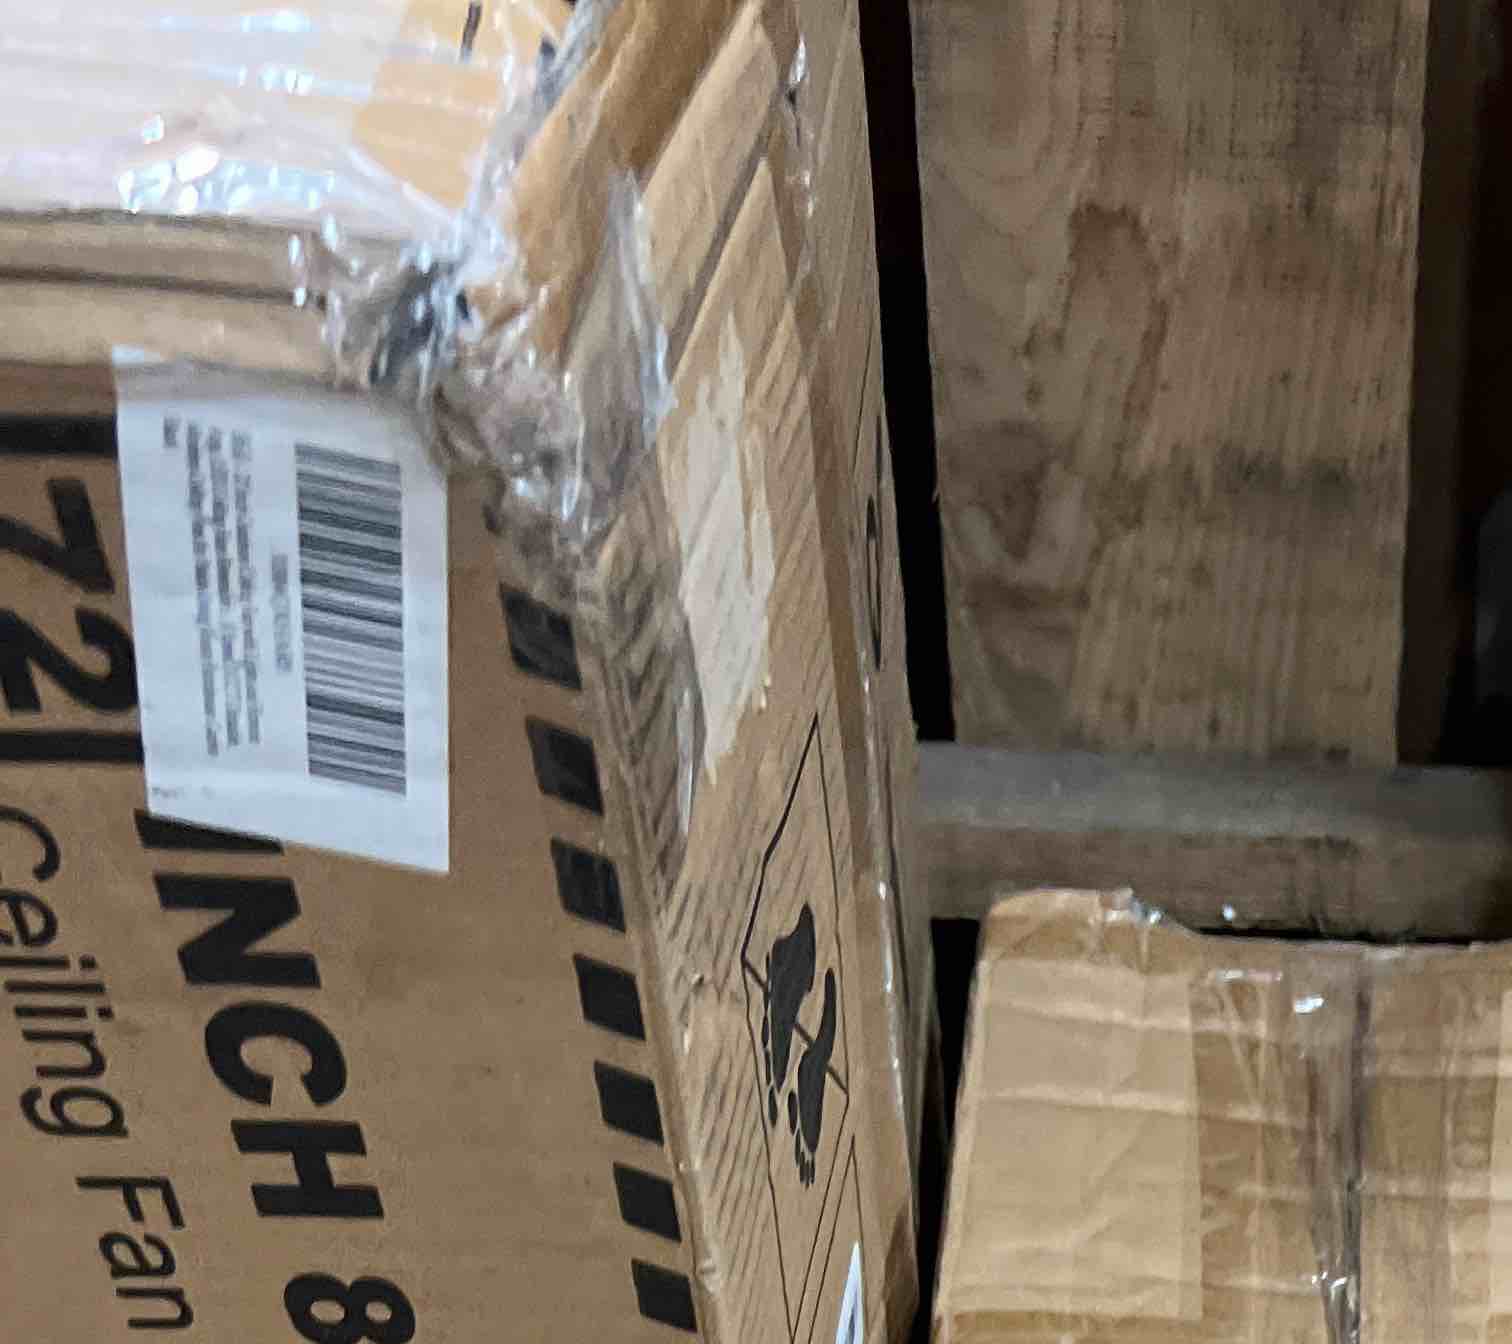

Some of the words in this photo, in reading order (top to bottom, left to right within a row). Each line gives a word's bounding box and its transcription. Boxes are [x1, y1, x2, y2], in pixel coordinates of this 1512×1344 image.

[0, 477, 138, 713] 72
[0, 808, 129, 1138] Ceiling
[76, 1176, 193, 1330] Fan
[134, 808, 383, 1220] INCH
